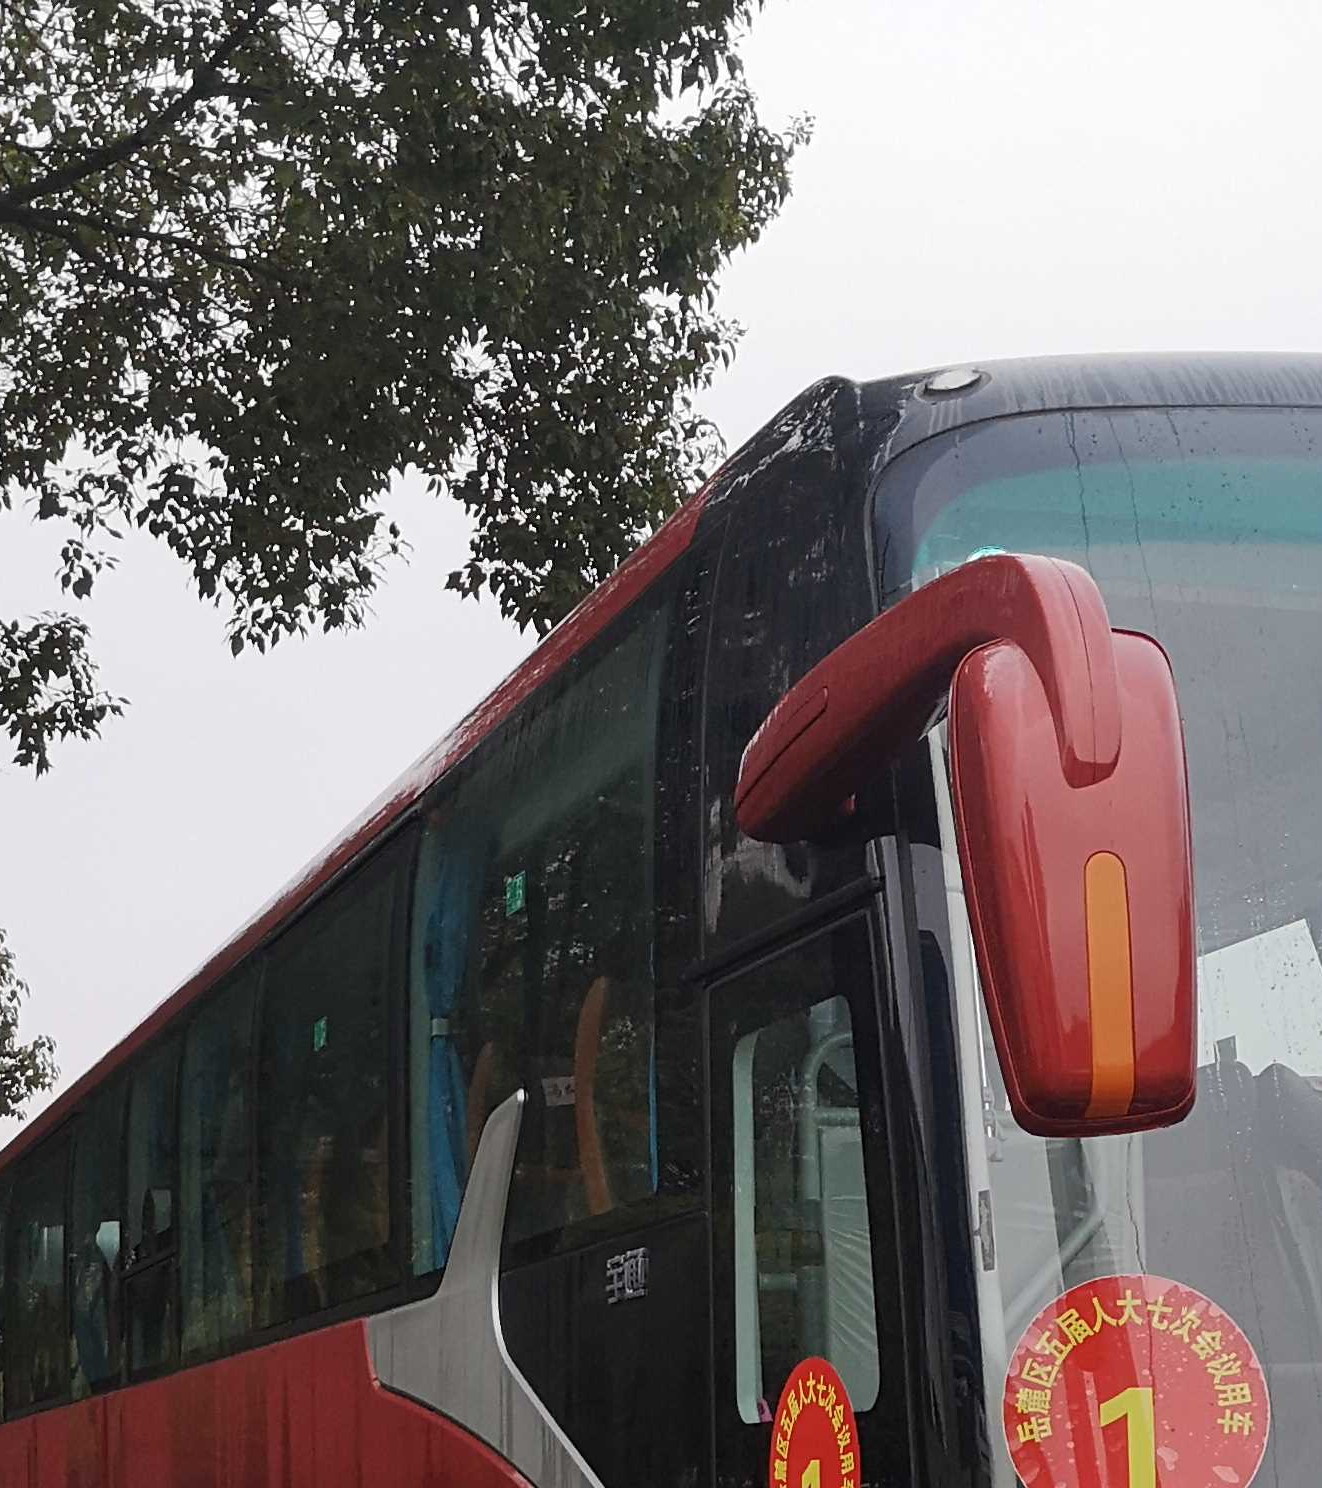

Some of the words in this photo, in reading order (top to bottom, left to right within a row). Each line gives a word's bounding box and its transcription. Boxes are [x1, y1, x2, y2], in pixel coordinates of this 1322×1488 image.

[1015, 1289, 1255, 1444] 岳麓区五届人大七次会议用车
